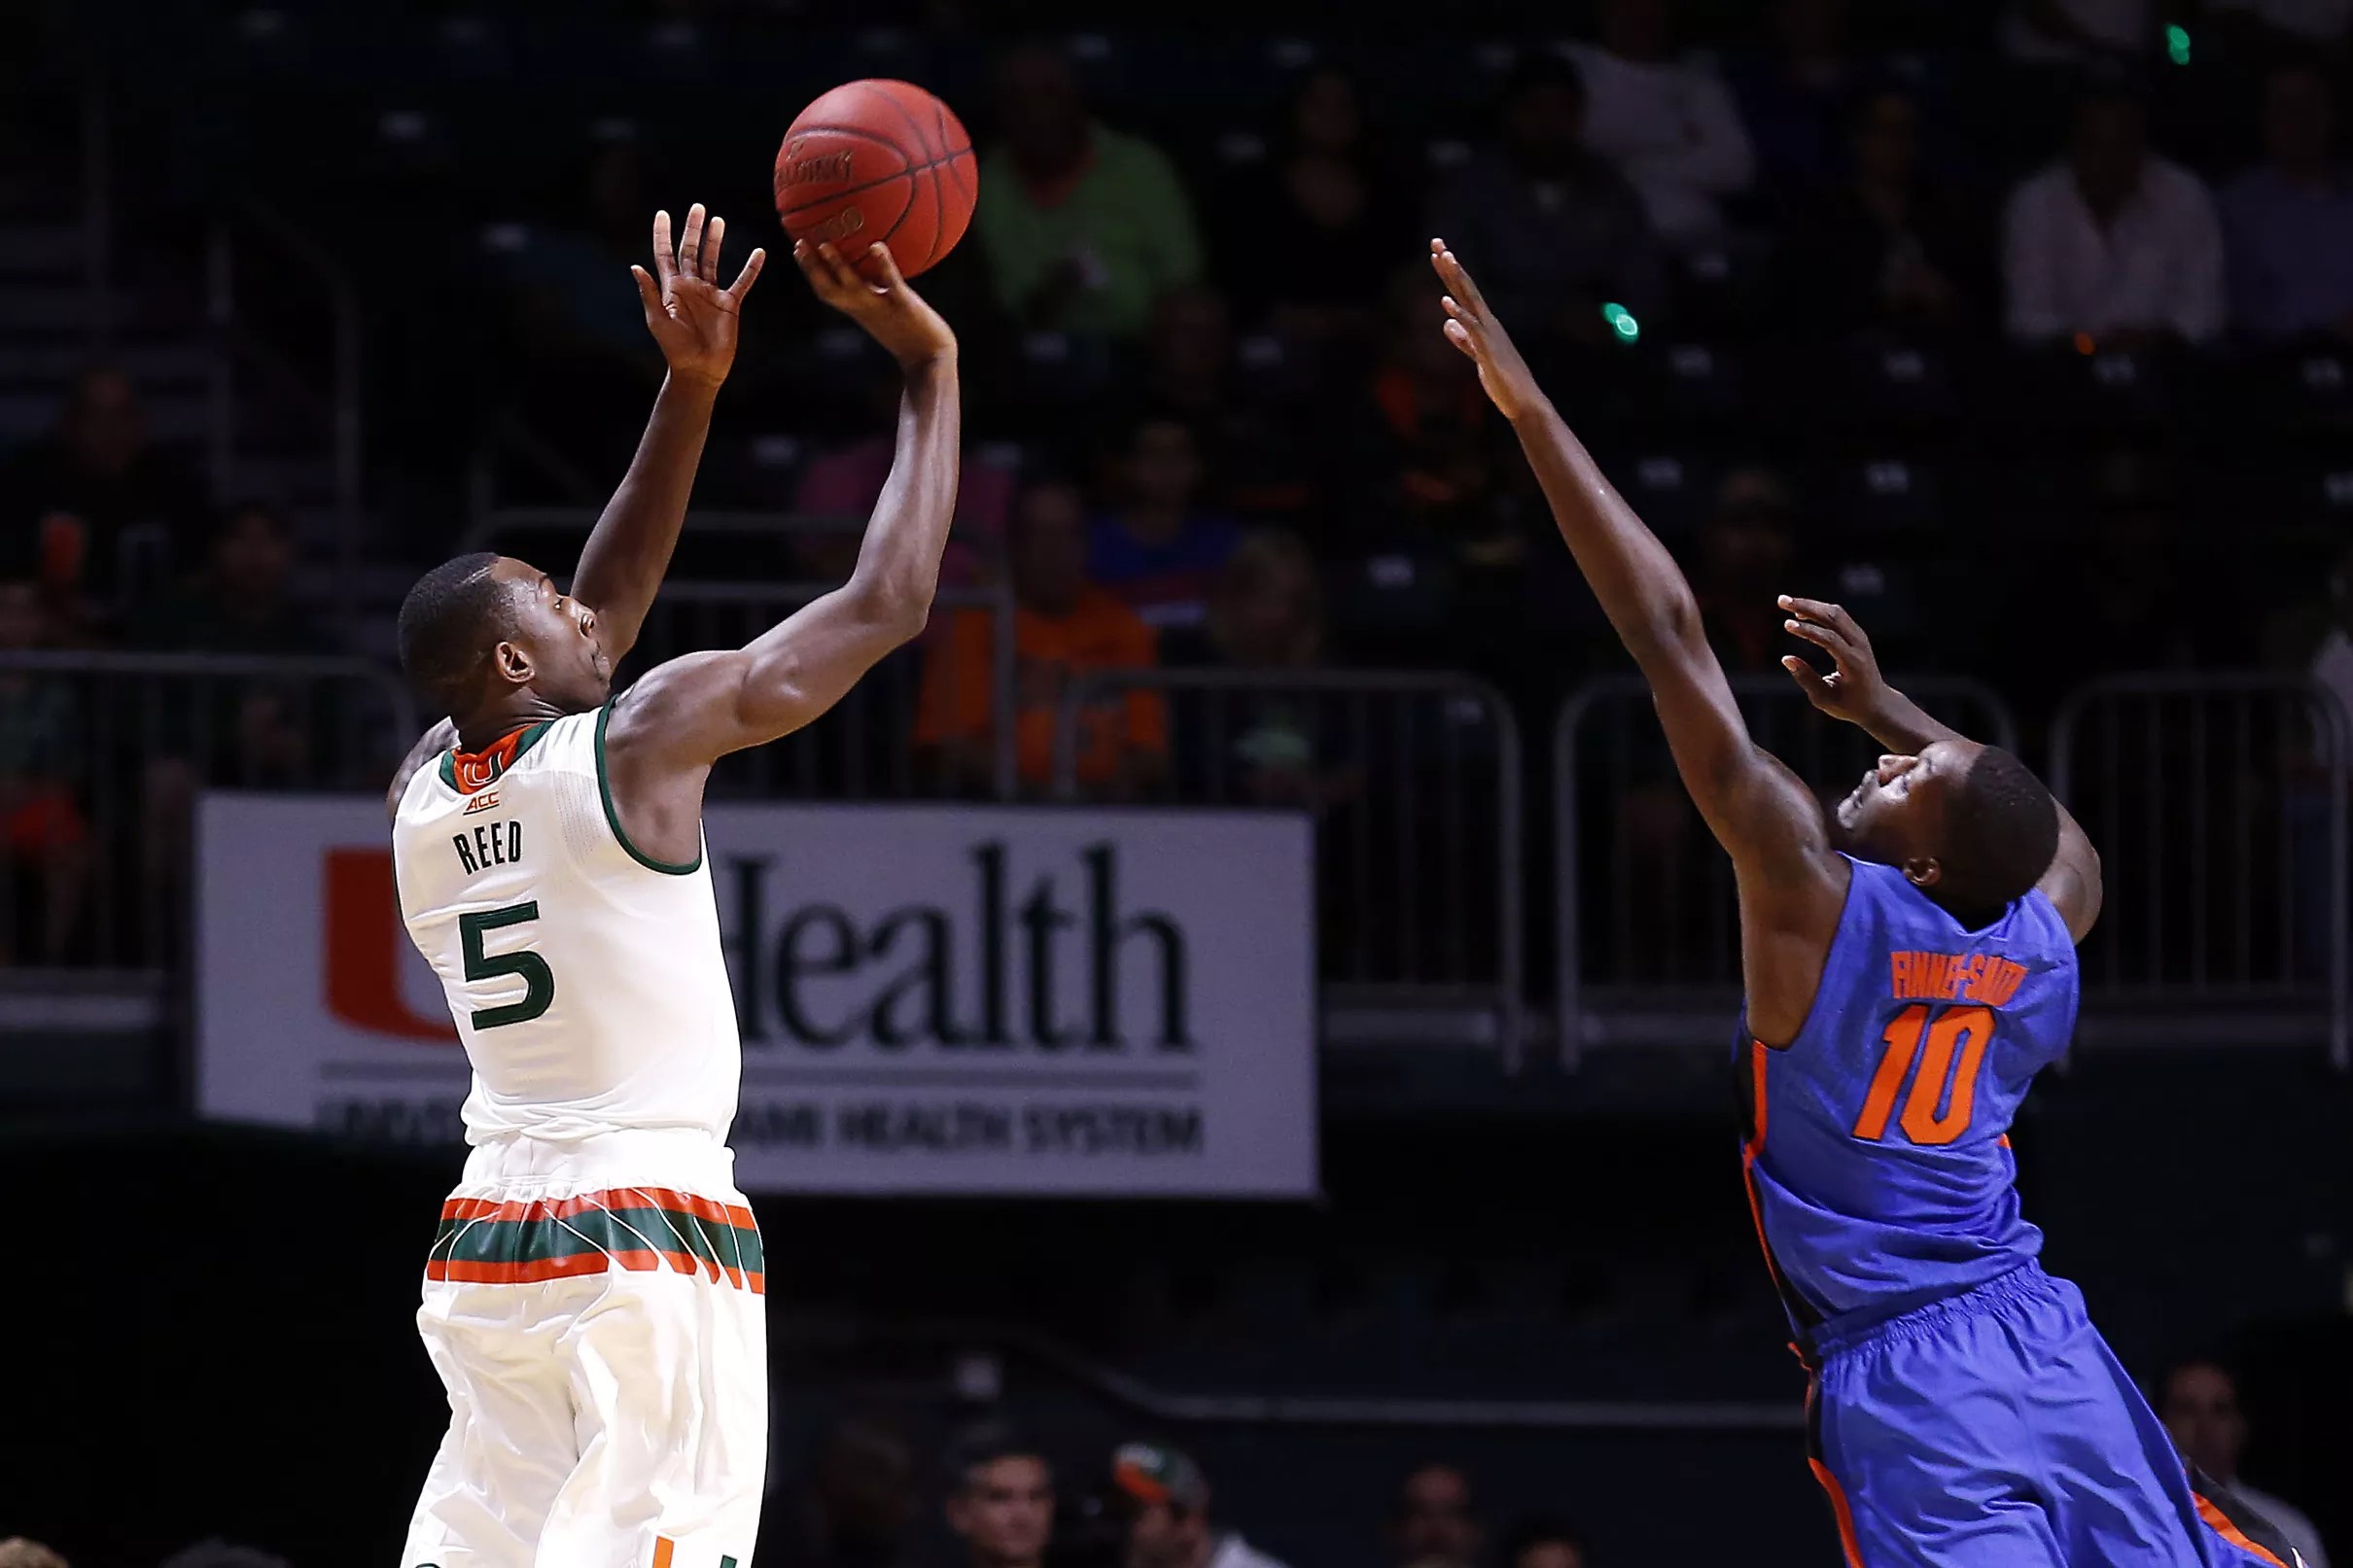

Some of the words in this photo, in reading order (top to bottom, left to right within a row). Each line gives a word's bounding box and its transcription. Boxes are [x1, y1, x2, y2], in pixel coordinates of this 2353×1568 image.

[452, 819, 523, 876] REED
[466, 790, 500, 813] ACC
[459, 900, 555, 1031] 5
[1851, 1003, 1996, 1144] 10
